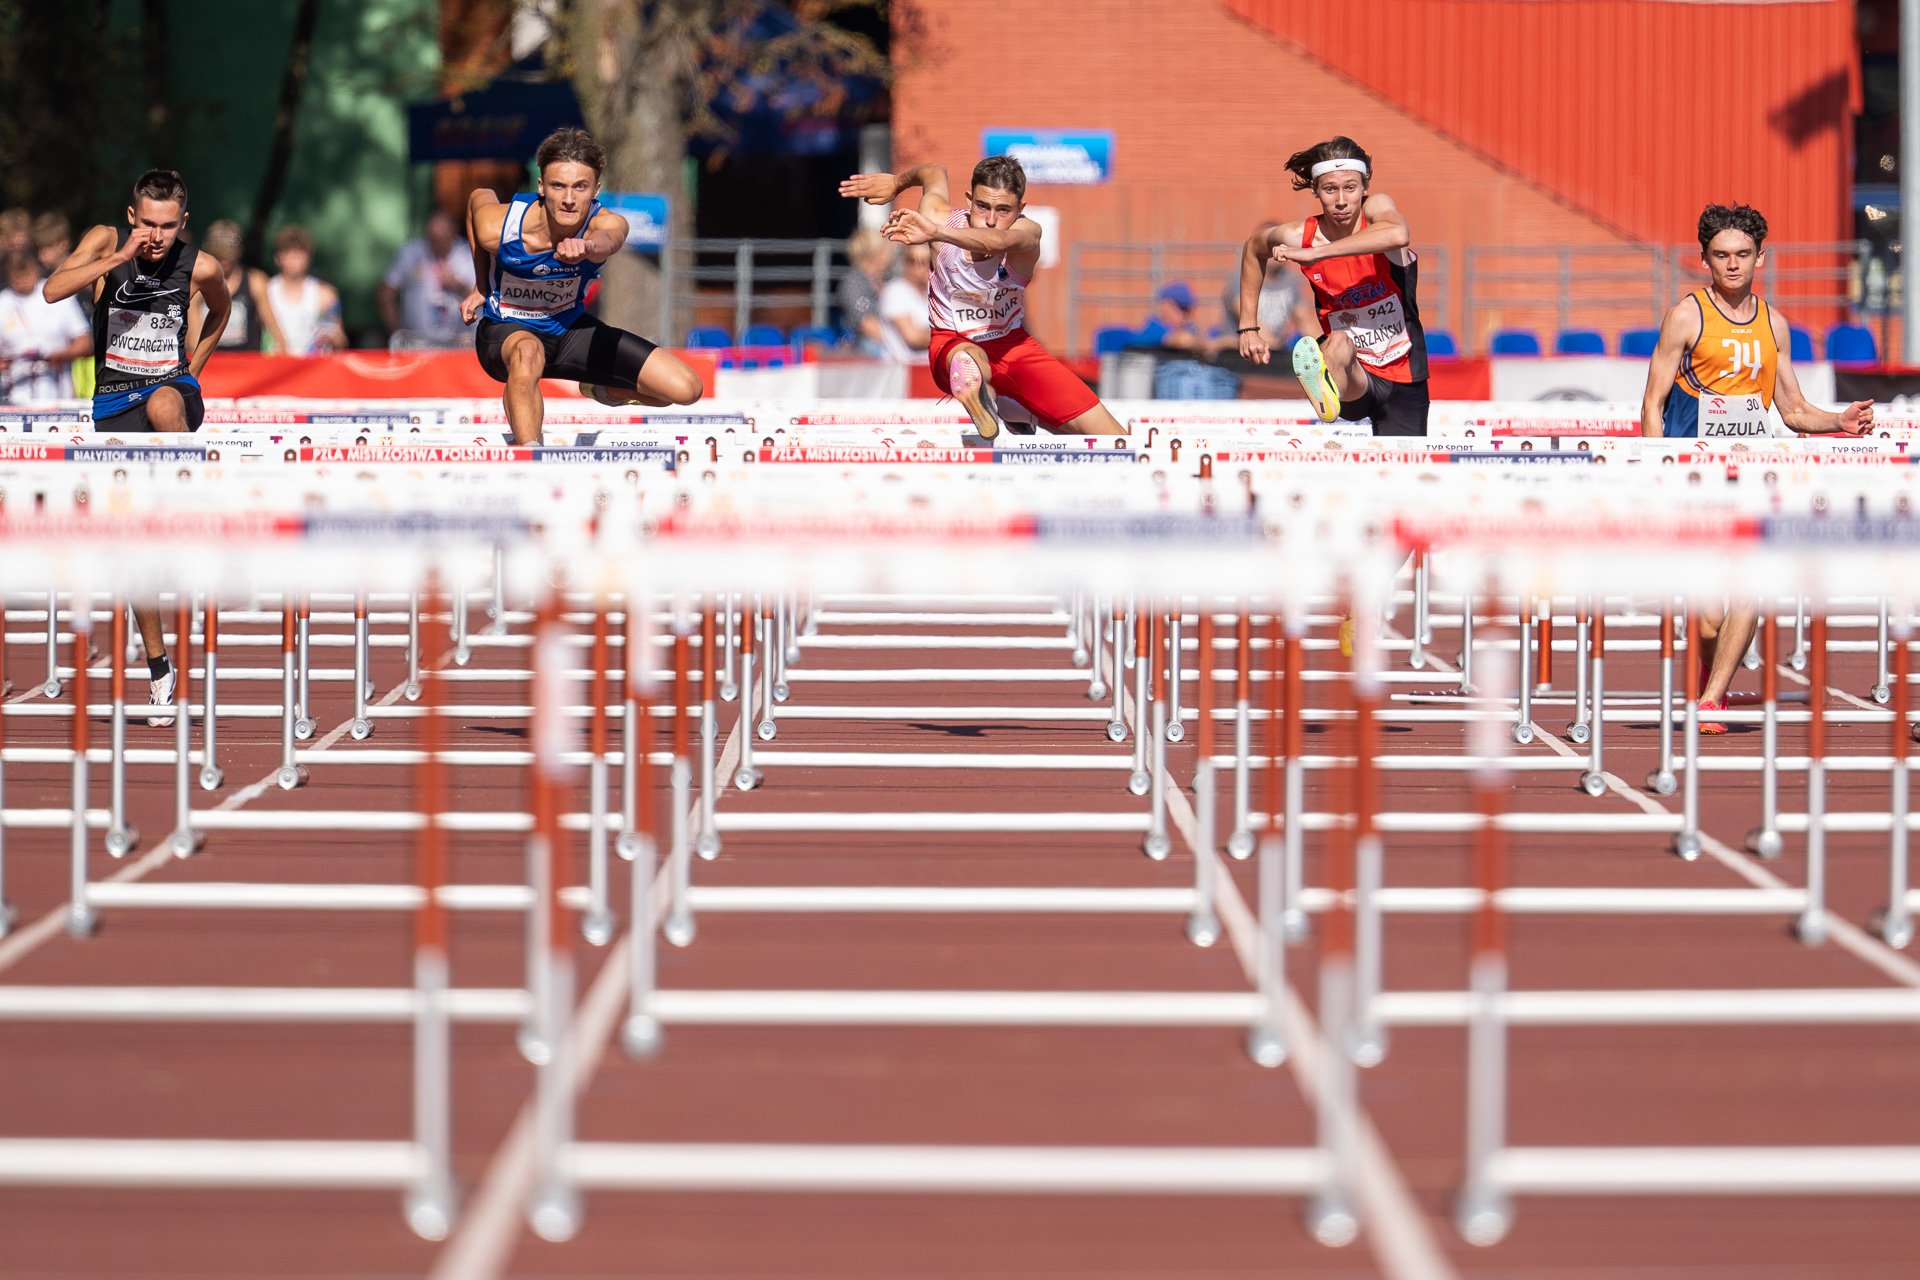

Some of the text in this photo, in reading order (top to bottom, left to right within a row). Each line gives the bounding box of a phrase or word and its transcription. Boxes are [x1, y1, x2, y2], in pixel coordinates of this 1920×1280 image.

[546, 279, 574, 289] 539
[504, 287, 574, 303] ADAMCZYK
[956, 296, 1018, 323] TROJNAR
[1368, 301, 1396, 320] 942
[150, 316, 175, 331] 832
[1354, 320, 1402, 348] BRZAŃSKI
[111, 333, 174, 353] OWCZARCZYK
[1719, 338, 1763, 380] 34
[98, 382, 134, 394] ROUGH
[1747, 398, 1759, 411] 30
[1705, 421, 1766, 437] ZAZULA
[24, 446, 47, 462] U16
[312, 447, 515, 462] PZLA MISTRZOSTWA POLSKI U16
[771, 448, 974, 463] PZLA MISTRZOSTWA POLSKI U16
